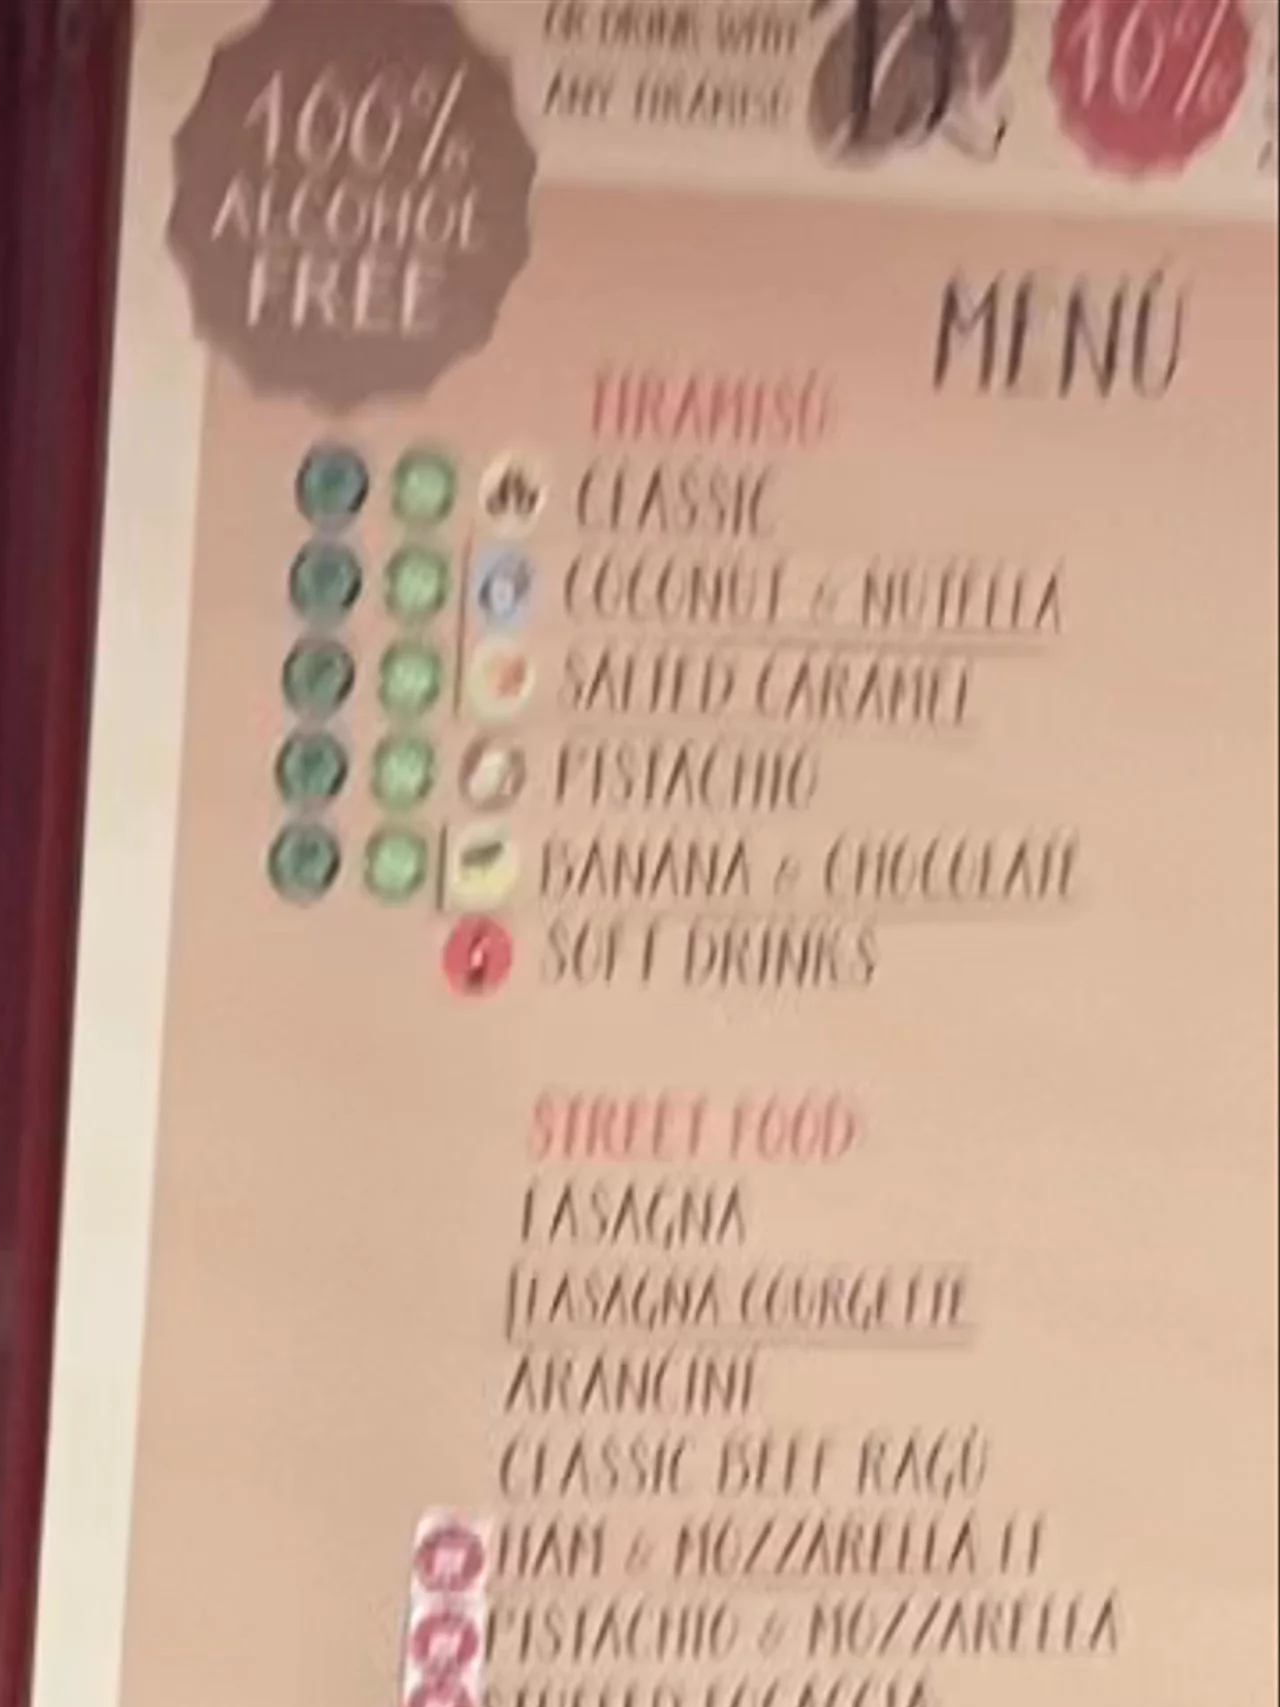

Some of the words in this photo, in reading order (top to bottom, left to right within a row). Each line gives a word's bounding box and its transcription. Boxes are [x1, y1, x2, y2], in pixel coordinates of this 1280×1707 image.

[242, 62, 473, 180] 100%
[210, 166, 485, 251] ALCOHOL
[245, 253, 442, 335] FREE
[575, 458, 777, 536] CLASSIC
[562, 551, 784, 628] COCONUT
[861, 556, 1063, 635] NUTELLA
[562, 646, 735, 714] SALTED
[755, 653, 974, 728] CARAMEL
[554, 737, 818, 811] PISTACHIO
[538, 828, 751, 900] BANANA
[824, 829, 1080, 900] CHOCOLATE
[542, 918, 663, 989] SOFT
[681, 920, 881, 989] DRINKS
[530, 1087, 712, 1162] STREET
[729, 1087, 861, 1162] FOOD
[520, 1175, 747, 1250] LASAGNA
[524, 1266, 721, 1332] LASAGNA
[503, 1349, 758, 1416] ARANCINI
[499, 1428, 693, 1499] CLASSIC
[716, 1430, 833, 1497] BEEF
[673, 1508, 977, 1579] MOZZARELLA
[484, 1597, 741, 1667] PISTACHIO
[806, 1587, 1120, 1661] MOZZARELLA
